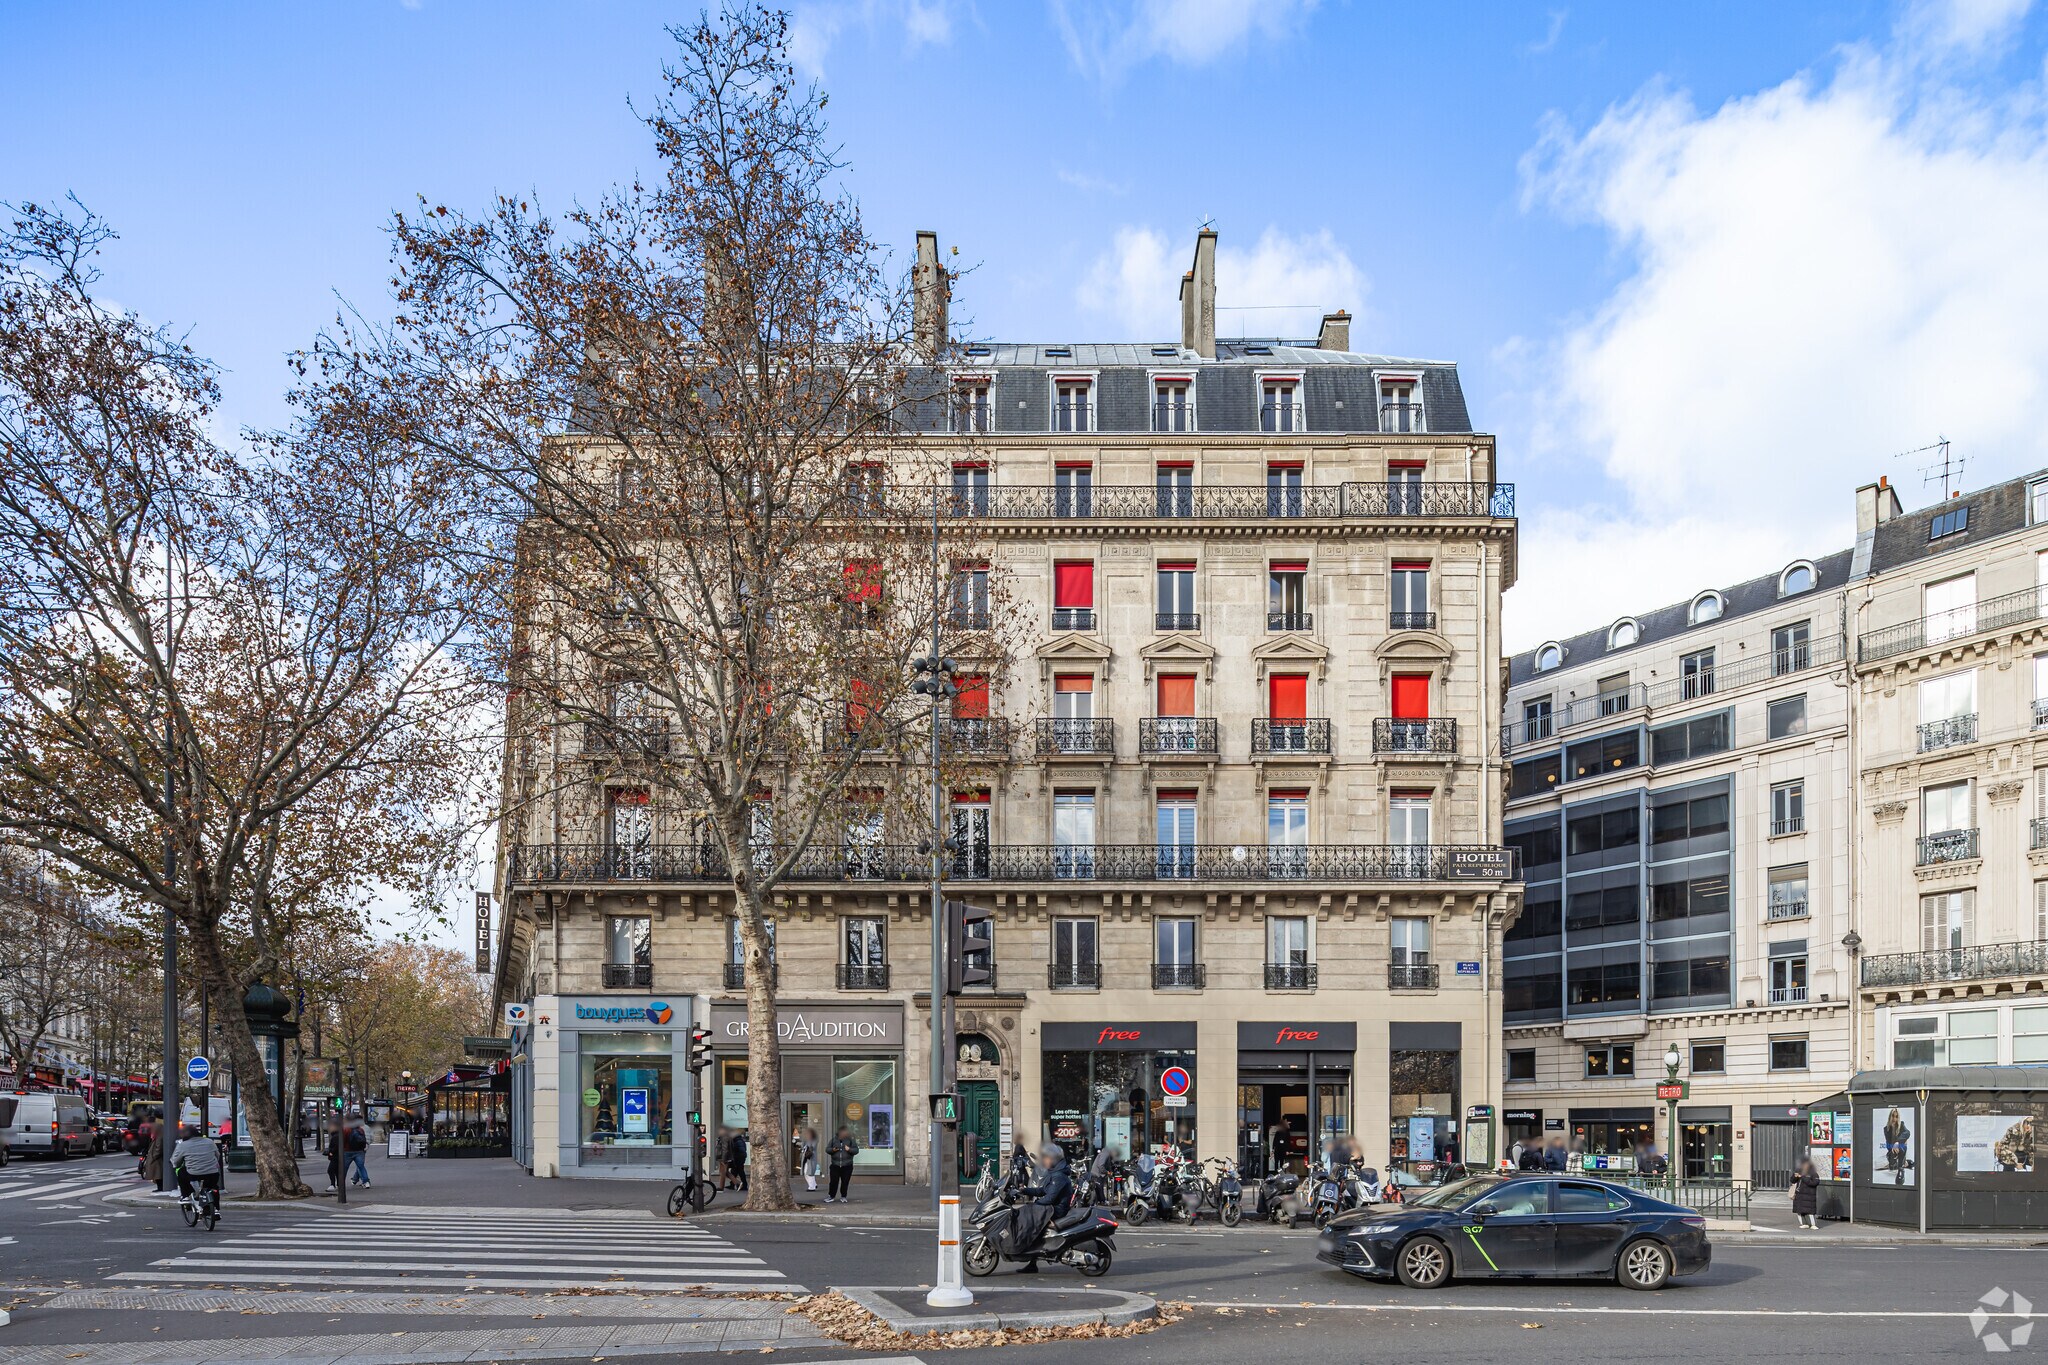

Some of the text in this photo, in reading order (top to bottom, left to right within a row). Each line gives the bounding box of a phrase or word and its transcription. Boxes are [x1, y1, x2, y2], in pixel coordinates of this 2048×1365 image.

[1456, 853, 1504, 862] HOTEL
[1482, 868, 1493, 876] 50
[477, 896, 489, 950] HOTEL
[576, 1003, 645, 1023] bouygues
[1097, 1027, 1141, 1044] free
[1275, 1027, 1319, 1044] free
[1506, 1111, 1535, 1119] morning
[1054, 1128, 1080, 1137] -200€
